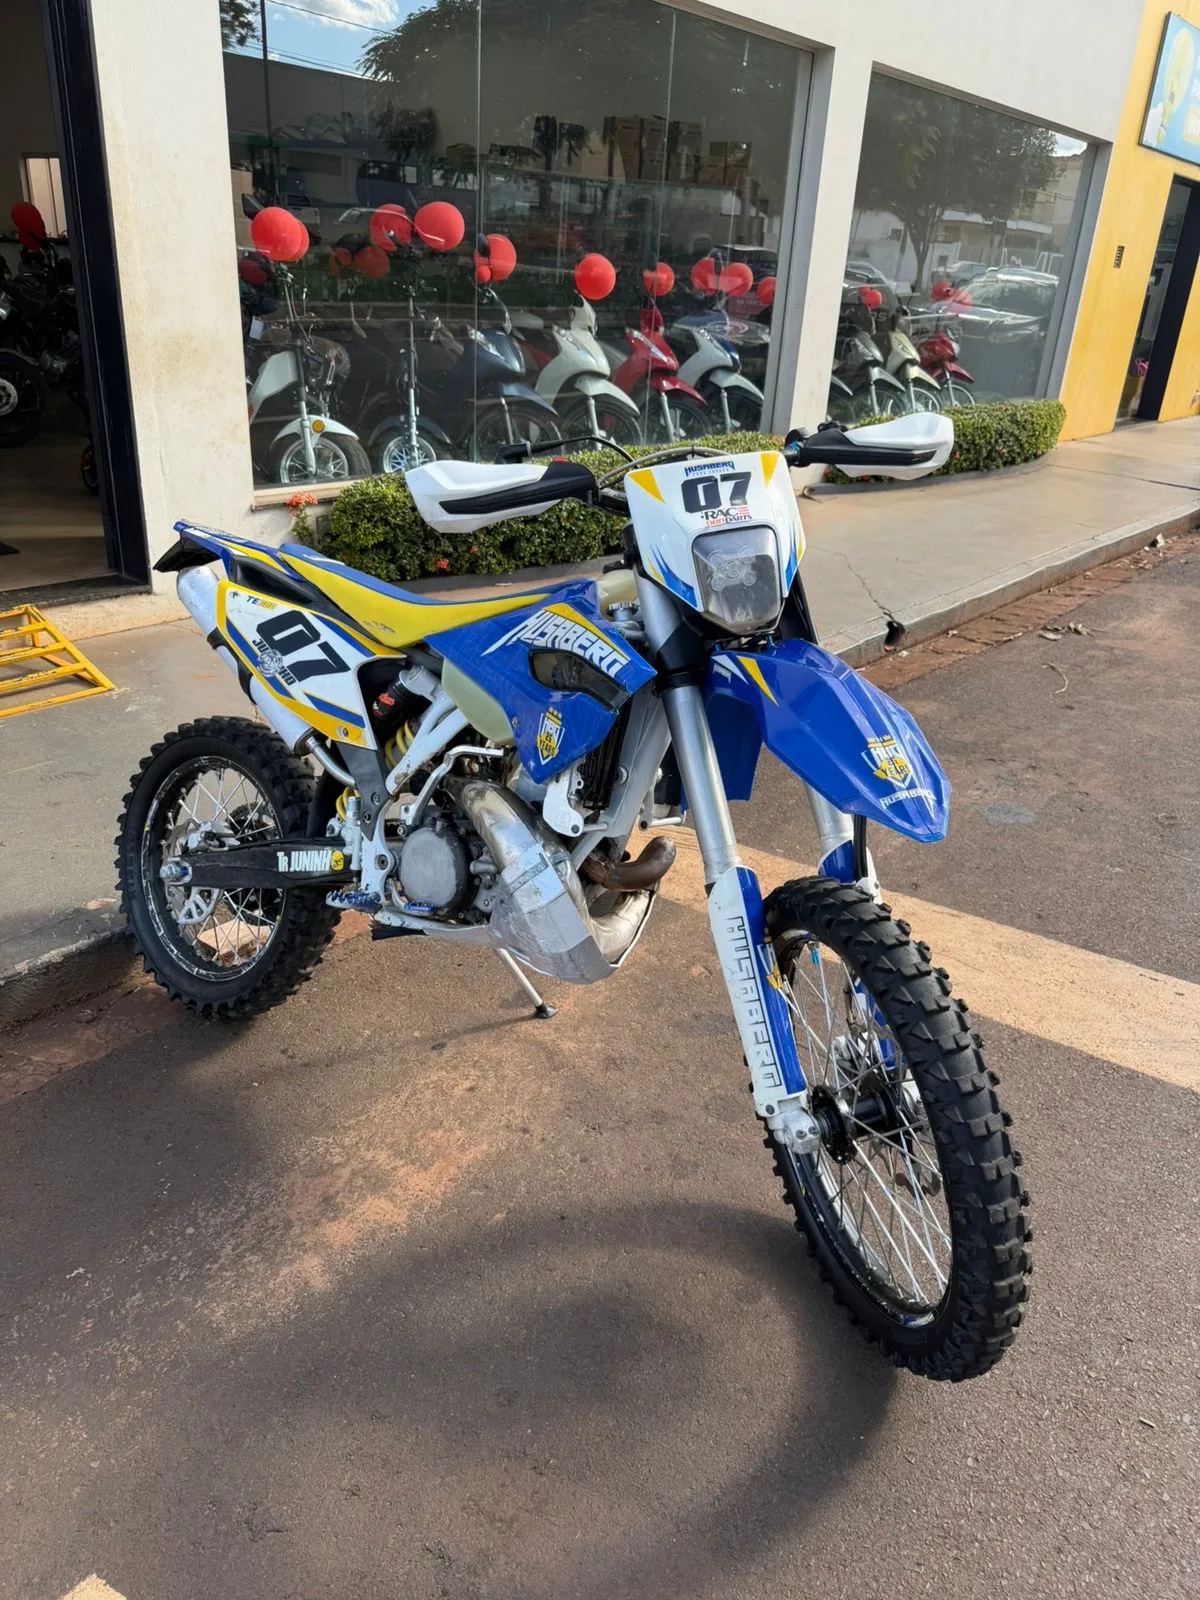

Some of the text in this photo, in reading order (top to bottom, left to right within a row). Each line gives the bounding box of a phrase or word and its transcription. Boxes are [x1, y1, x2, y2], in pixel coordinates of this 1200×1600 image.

[681, 471, 751, 514] 07
[684, 460, 736, 477] HUSABERG
[256, 610, 351, 683] 07
[480, 609, 631, 678] HUSABERG
[724, 915, 783, 1088] HUSABERG
